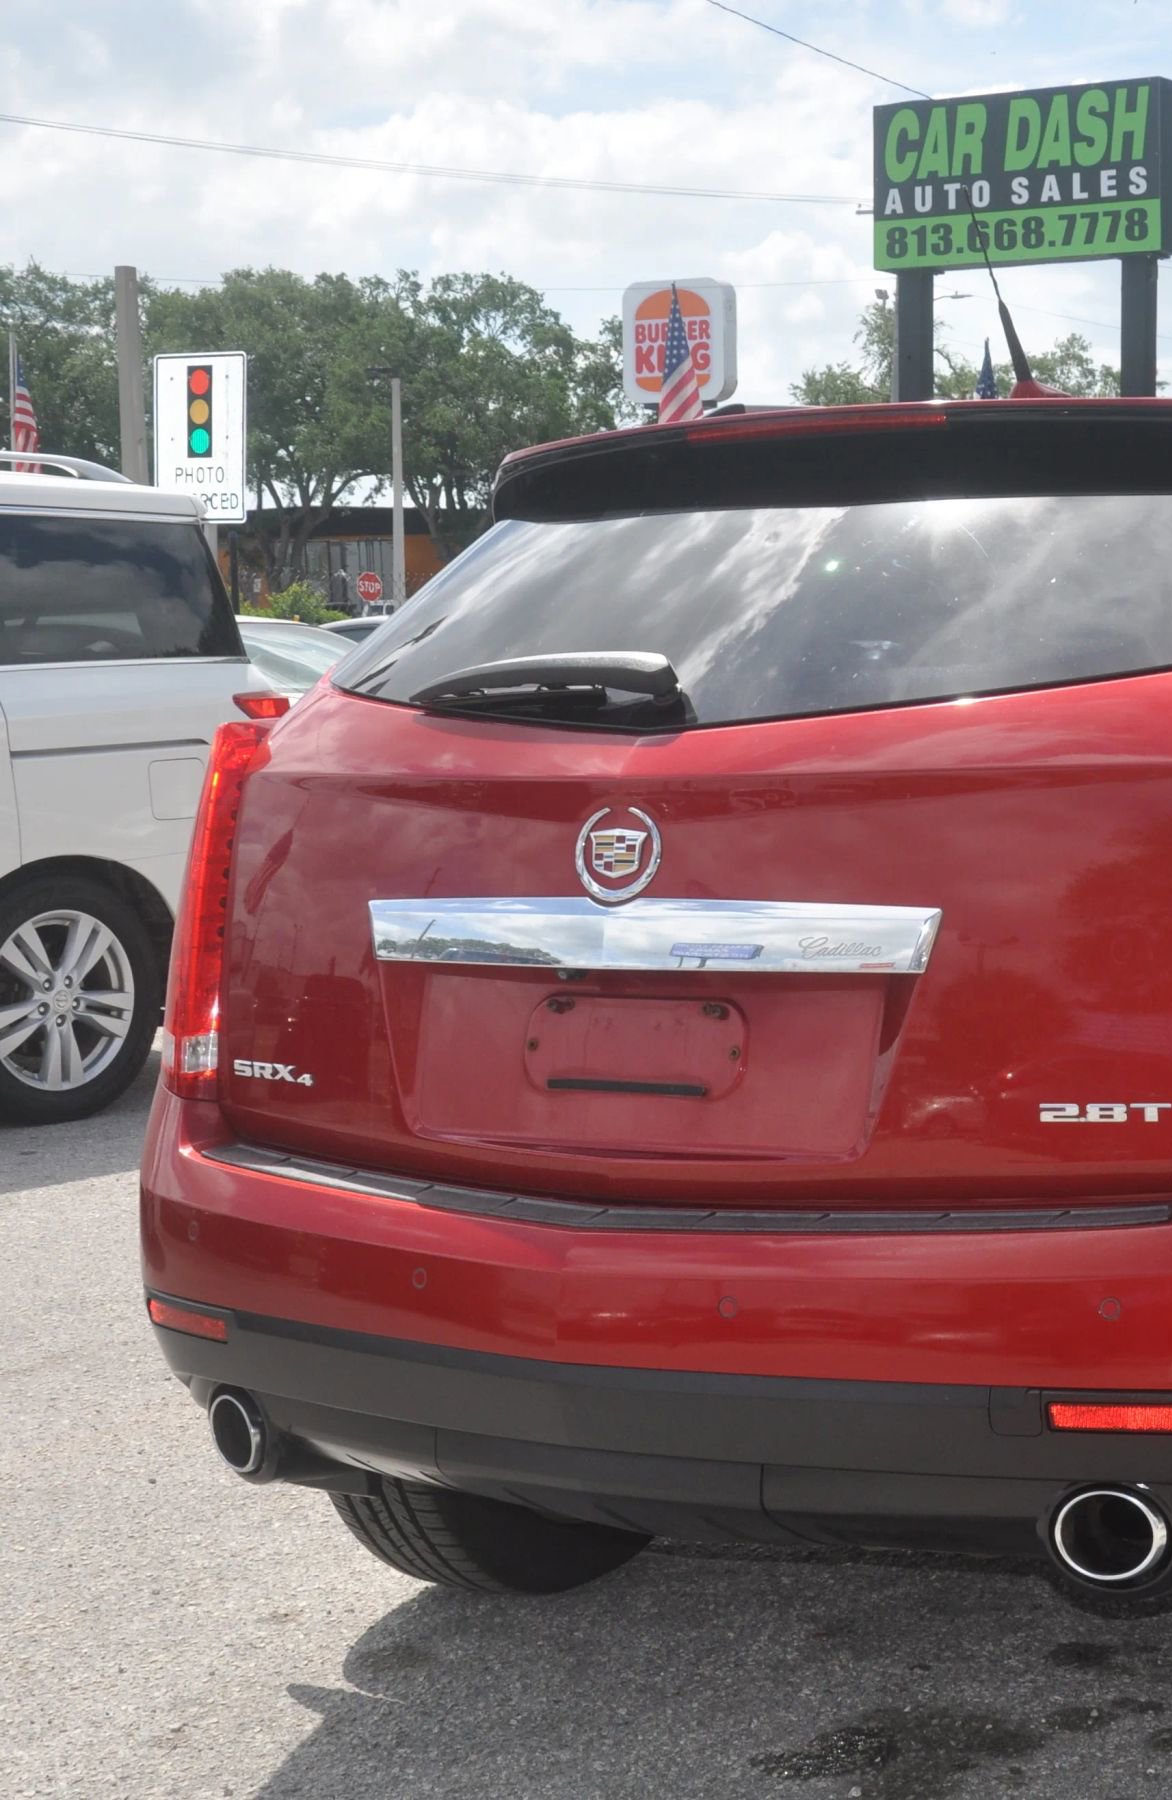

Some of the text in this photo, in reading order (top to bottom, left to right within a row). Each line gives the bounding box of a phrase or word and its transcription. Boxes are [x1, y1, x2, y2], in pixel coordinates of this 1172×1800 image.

[884, 85, 1150, 183] CAR DASH
[884, 166, 1148, 216] AUTO SALES
[885, 207, 1150, 259] 813.668.7778
[635, 319, 711, 344] BUER
[635, 342, 711, 374] KIG
[175, 466, 225, 484] PHOTO
[359, 580, 381, 594] STOP
[798, 936, 883, 960] Cadillac
[1039, 1103, 1172, 1122] 2.8T
